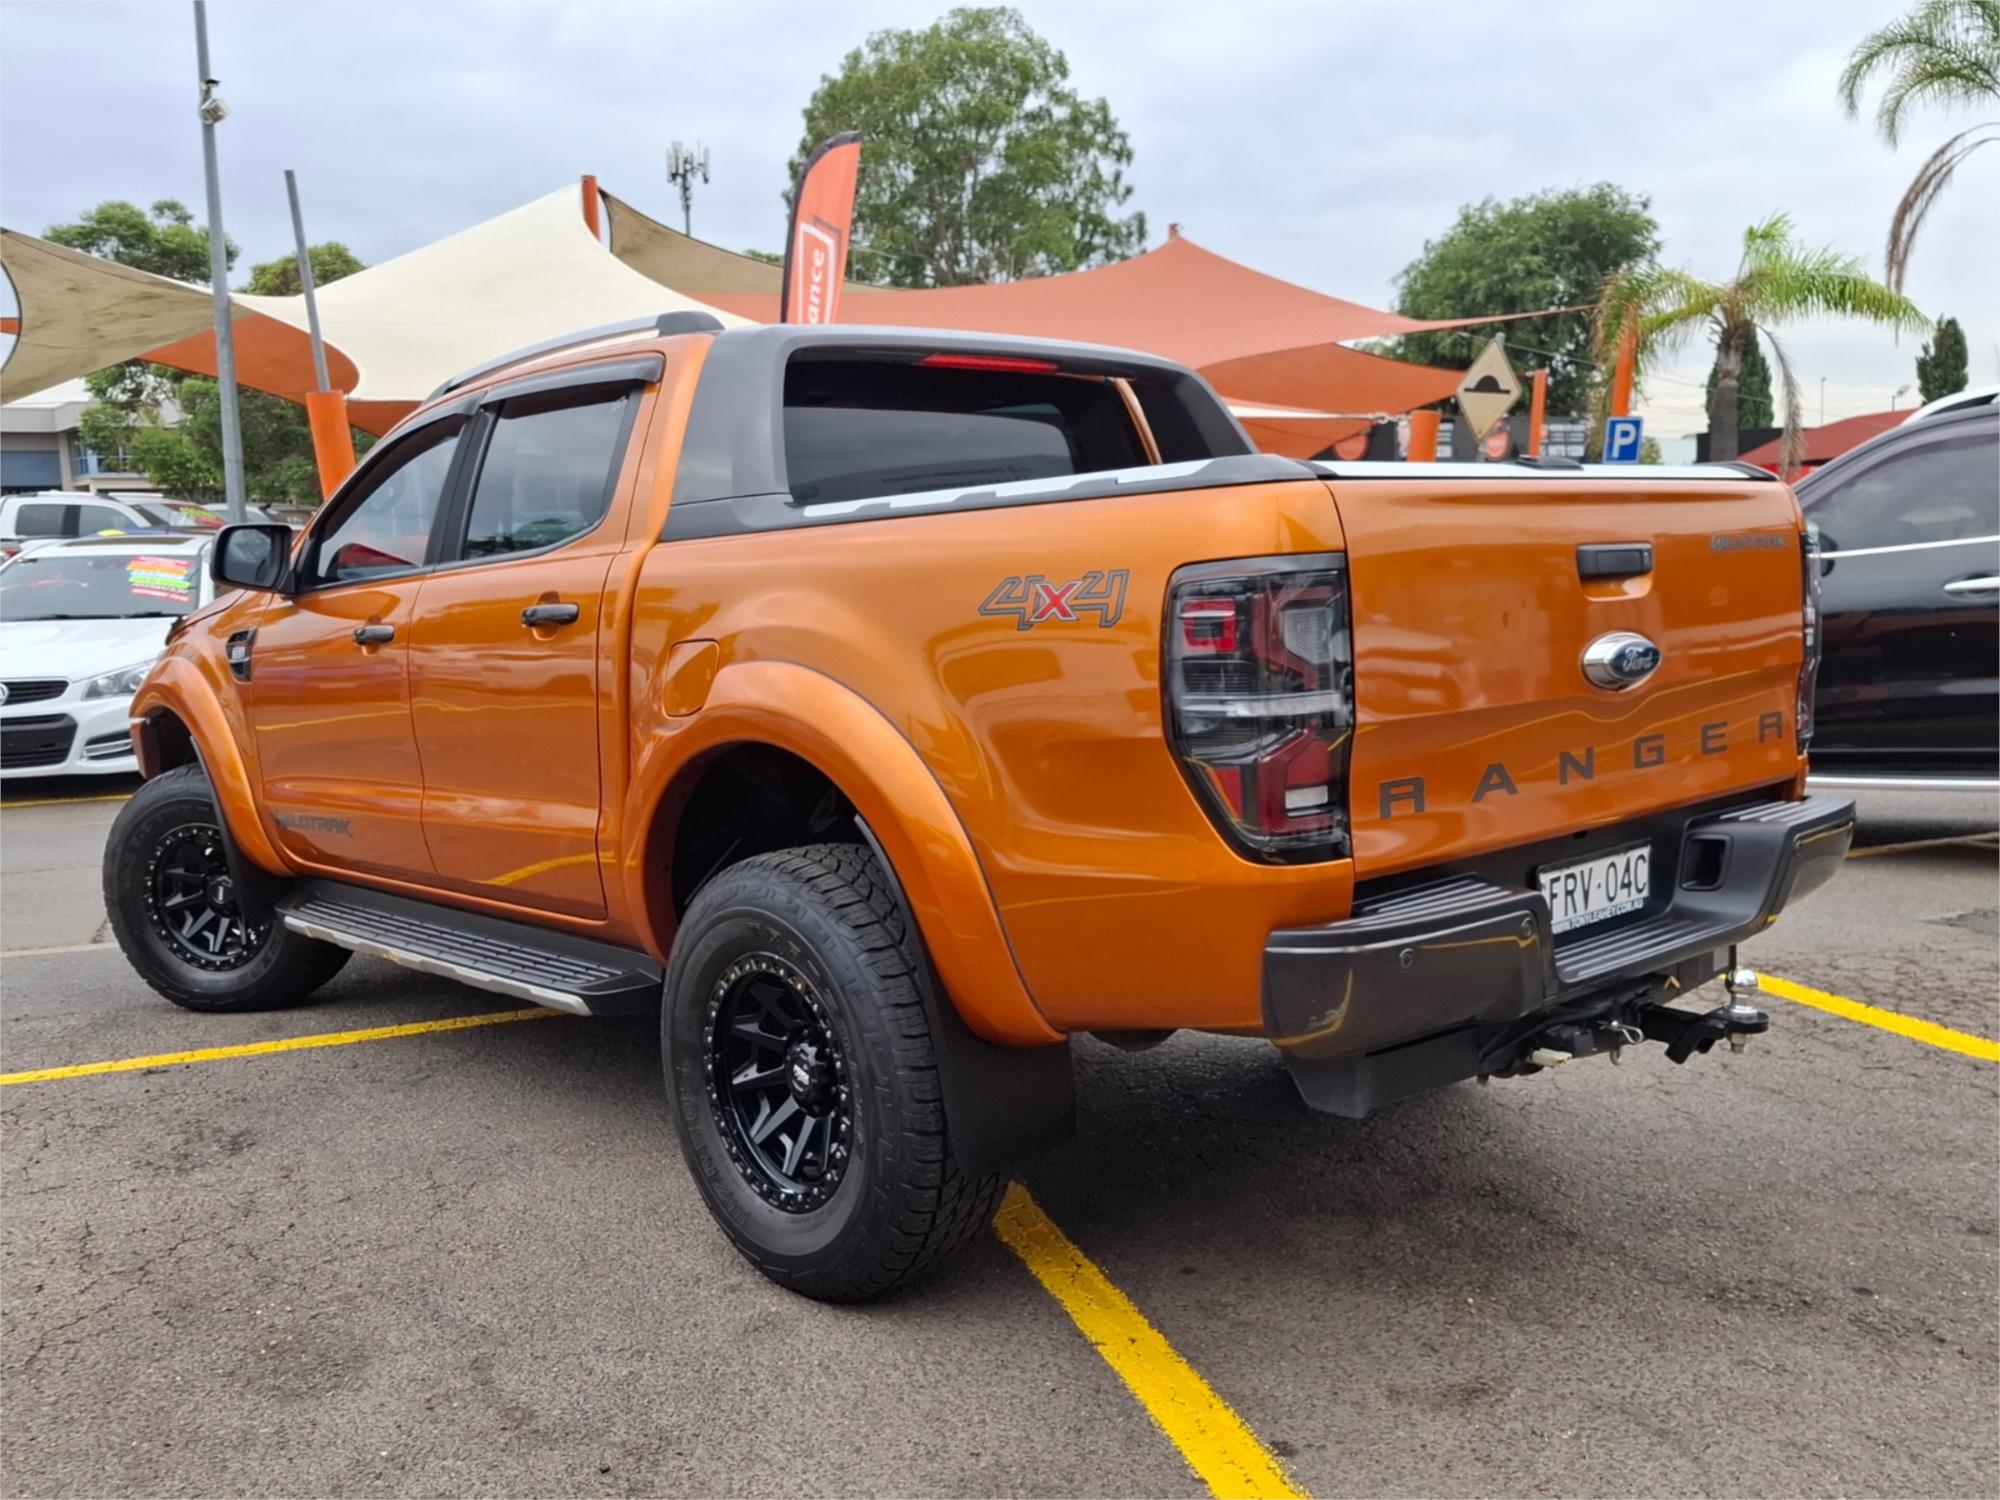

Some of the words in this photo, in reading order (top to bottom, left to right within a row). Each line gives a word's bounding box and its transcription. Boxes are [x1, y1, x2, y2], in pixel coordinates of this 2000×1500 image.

[1612, 423, 1637, 459] P
[1622, 646, 1653, 672] Ford
[1379, 710, 1784, 820] RANGER
